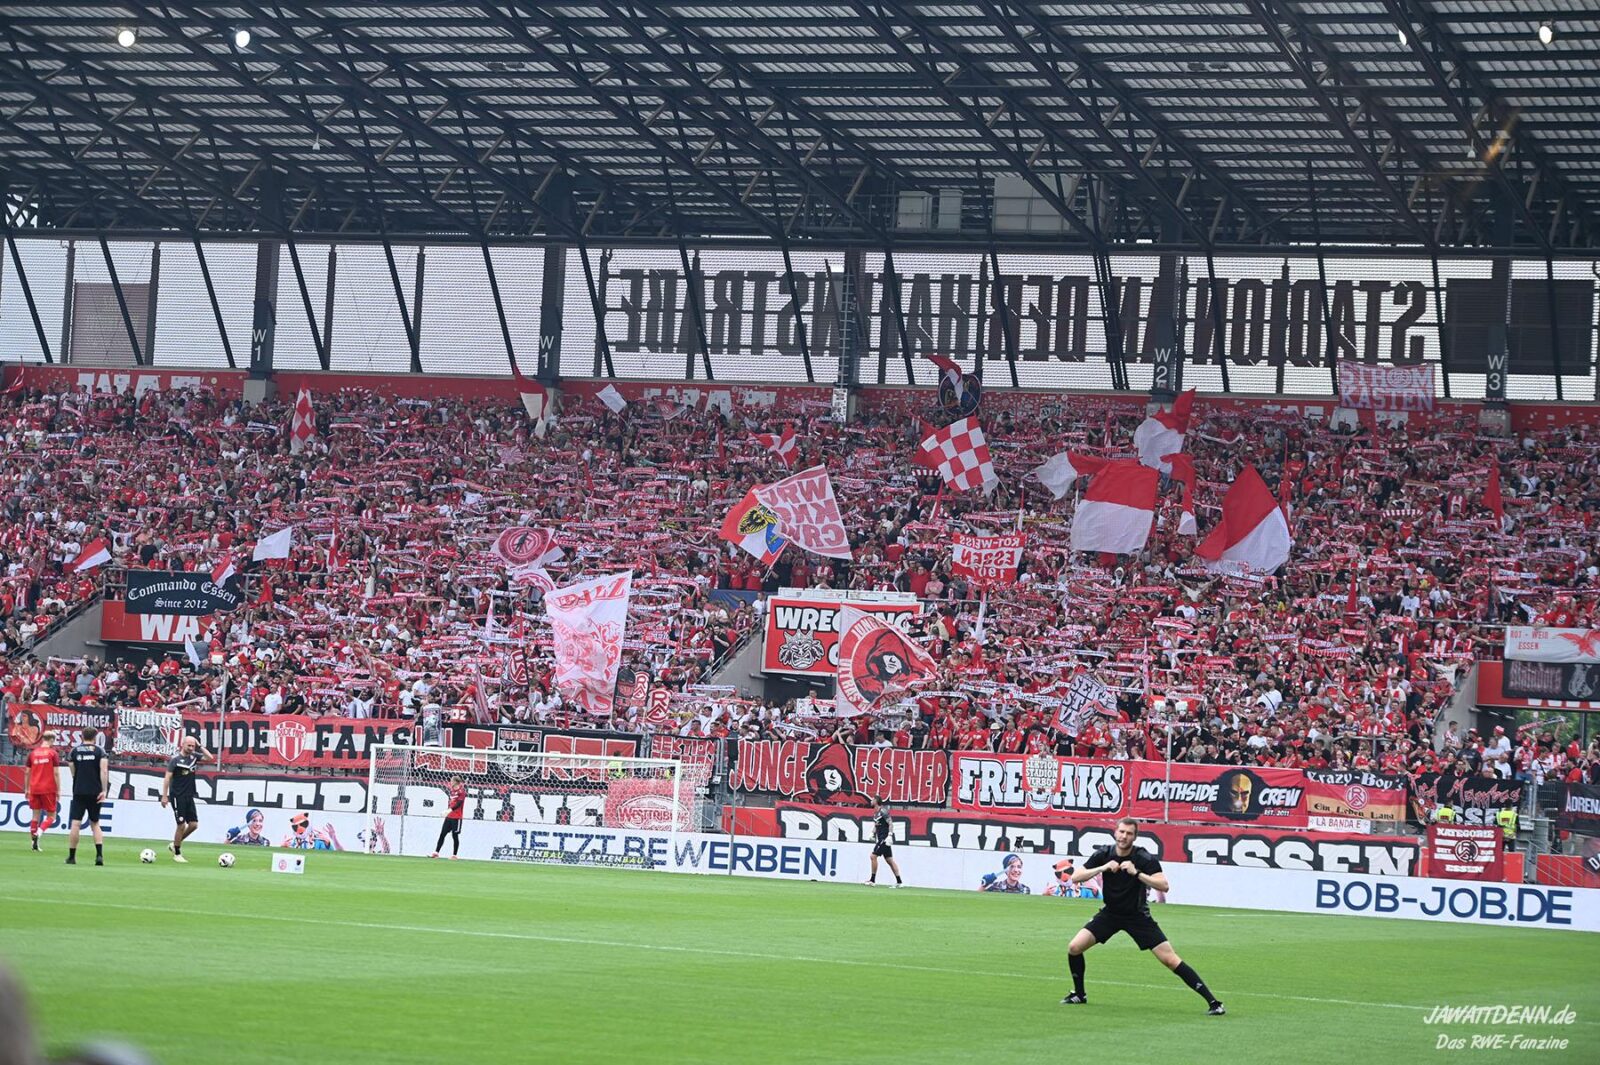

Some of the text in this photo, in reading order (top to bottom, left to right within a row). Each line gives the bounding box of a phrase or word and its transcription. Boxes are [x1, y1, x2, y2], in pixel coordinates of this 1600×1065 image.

[252, 328, 266, 343] W
[540, 335, 554, 350] W
[254, 346, 261, 362] 1
[542, 352, 548, 369] 1
[1155, 347, 1171, 363] W
[1488, 354, 1504, 370] W
[1156, 366, 1168, 382] 2
[1489, 372, 1501, 391] 3
[1340, 386, 1434, 411] KASTEN
[128, 579, 237, 604] Commando Essen
[154, 597, 208, 609] Since 2012
[184, 720, 411, 760] RUDE FANS
[652, 735, 716, 755] SEKTION
[729, 740, 949, 804] JUNGE ESSENER
[1026, 760, 1058, 770] SEKTION
[1026, 769, 1058, 779] STADION
[959, 757, 1124, 813] FREAKS
[1027, 778, 1057, 787] VERBOT
[1138, 780, 1302, 808] NORTHSIDE CREW
[1316, 817, 1327, 827] LA
[1328, 818, 1354, 829] BANDA
[501, 849, 565, 860] GARTENBAU
[515, 829, 837, 877] JETZT BEWERBEN!
[579, 854, 645, 866] GARTENBAU
[1188, 838, 1414, 877] ESSEN
[1315, 879, 1573, 925] BOB-JOB.DE
